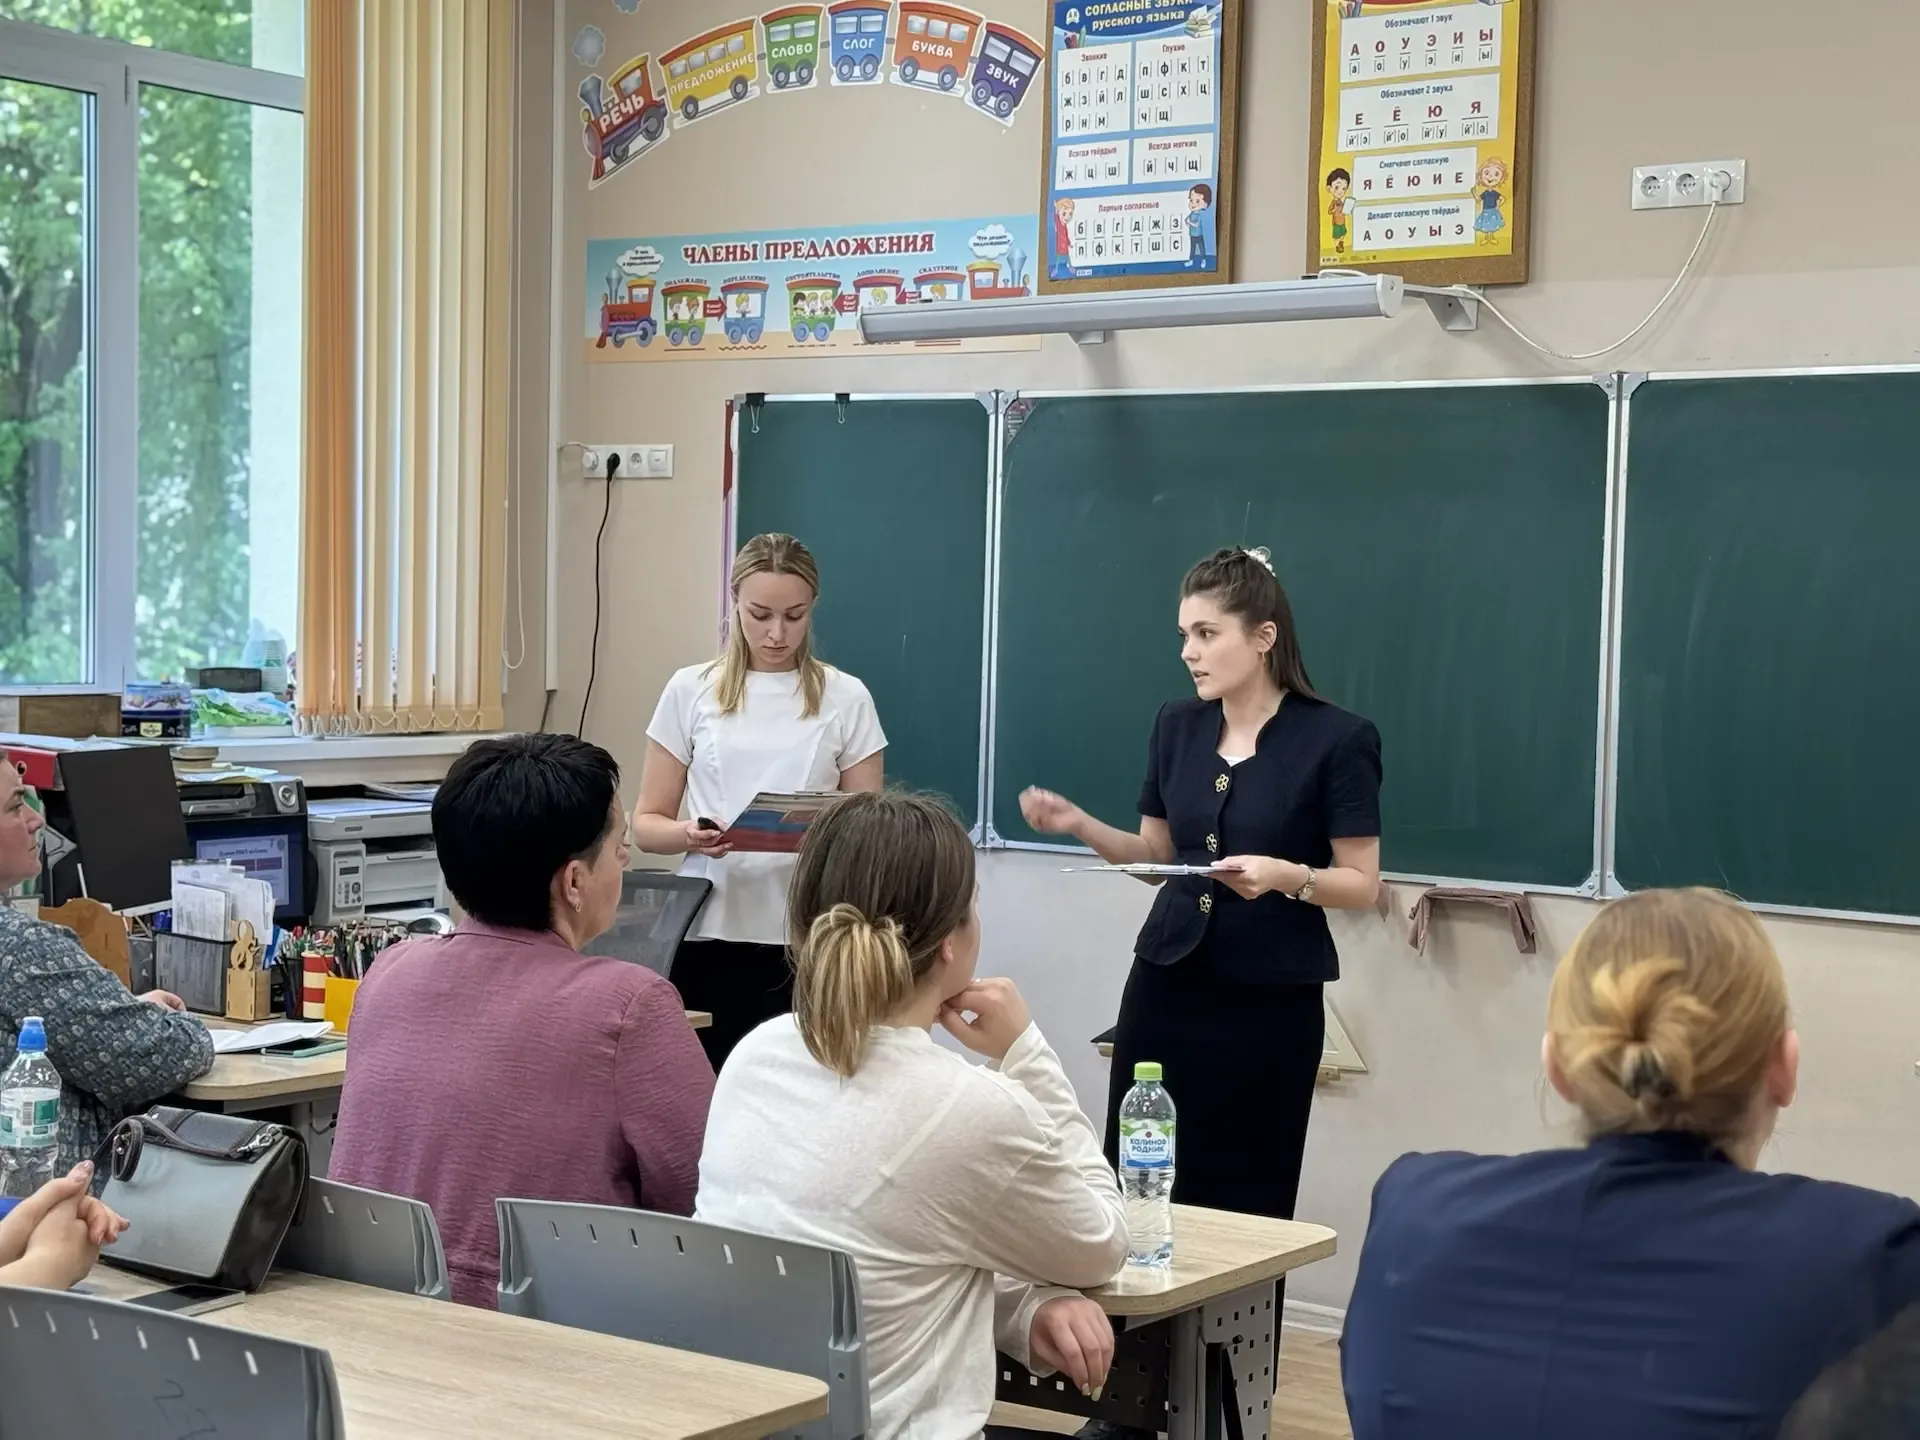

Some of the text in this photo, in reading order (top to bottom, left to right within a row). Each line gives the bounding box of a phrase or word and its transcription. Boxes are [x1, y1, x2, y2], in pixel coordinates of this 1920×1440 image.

[1085, 0, 1152, 17] СОГЛАСНЫЕ
[1092, 15, 1143, 31] русского
[1146, 10, 1185, 23] языка
[1385, 16, 1429, 29] Обозначают
[1436, 14, 1453, 24] звук
[843, 38, 876, 50] СЛОГ
[912, 40, 953, 58] БУКВА
[1162, 44, 1185, 54] Глухие
[1350, 28, 1493, 56] А О У Э И Ы
[771, 43, 813, 58] СЛОВО
[1081, 53, 1107, 62] Звонкие
[670, 52, 755, 95] ПРЕДЛОЖЕНИЕ
[986, 63, 1020, 88] ЗВУК
[1381, 84, 1453, 99] Обозначают 2 звука
[600, 94, 645, 133] РЕЧЬ
[1355, 101, 1481, 125] Е Ё Ю Я
[1149, 140, 1197, 151] Всегда мягкие
[1068, 150, 1089, 158] Всегда
[1412, 157, 1449, 166] согласную
[1363, 172, 1463, 190] Я Ё Ю И Е
[1098, 202, 1159, 213] Парные согласные
[1367, 206, 1460, 221] Делают согласную твёрдой
[1363, 224, 1464, 241] А О У Ы Э
[682, 244, 758, 264] ЧЛЕНЫ
[764, 234, 935, 261] ПРЕДЛОЖЕНИЯ
